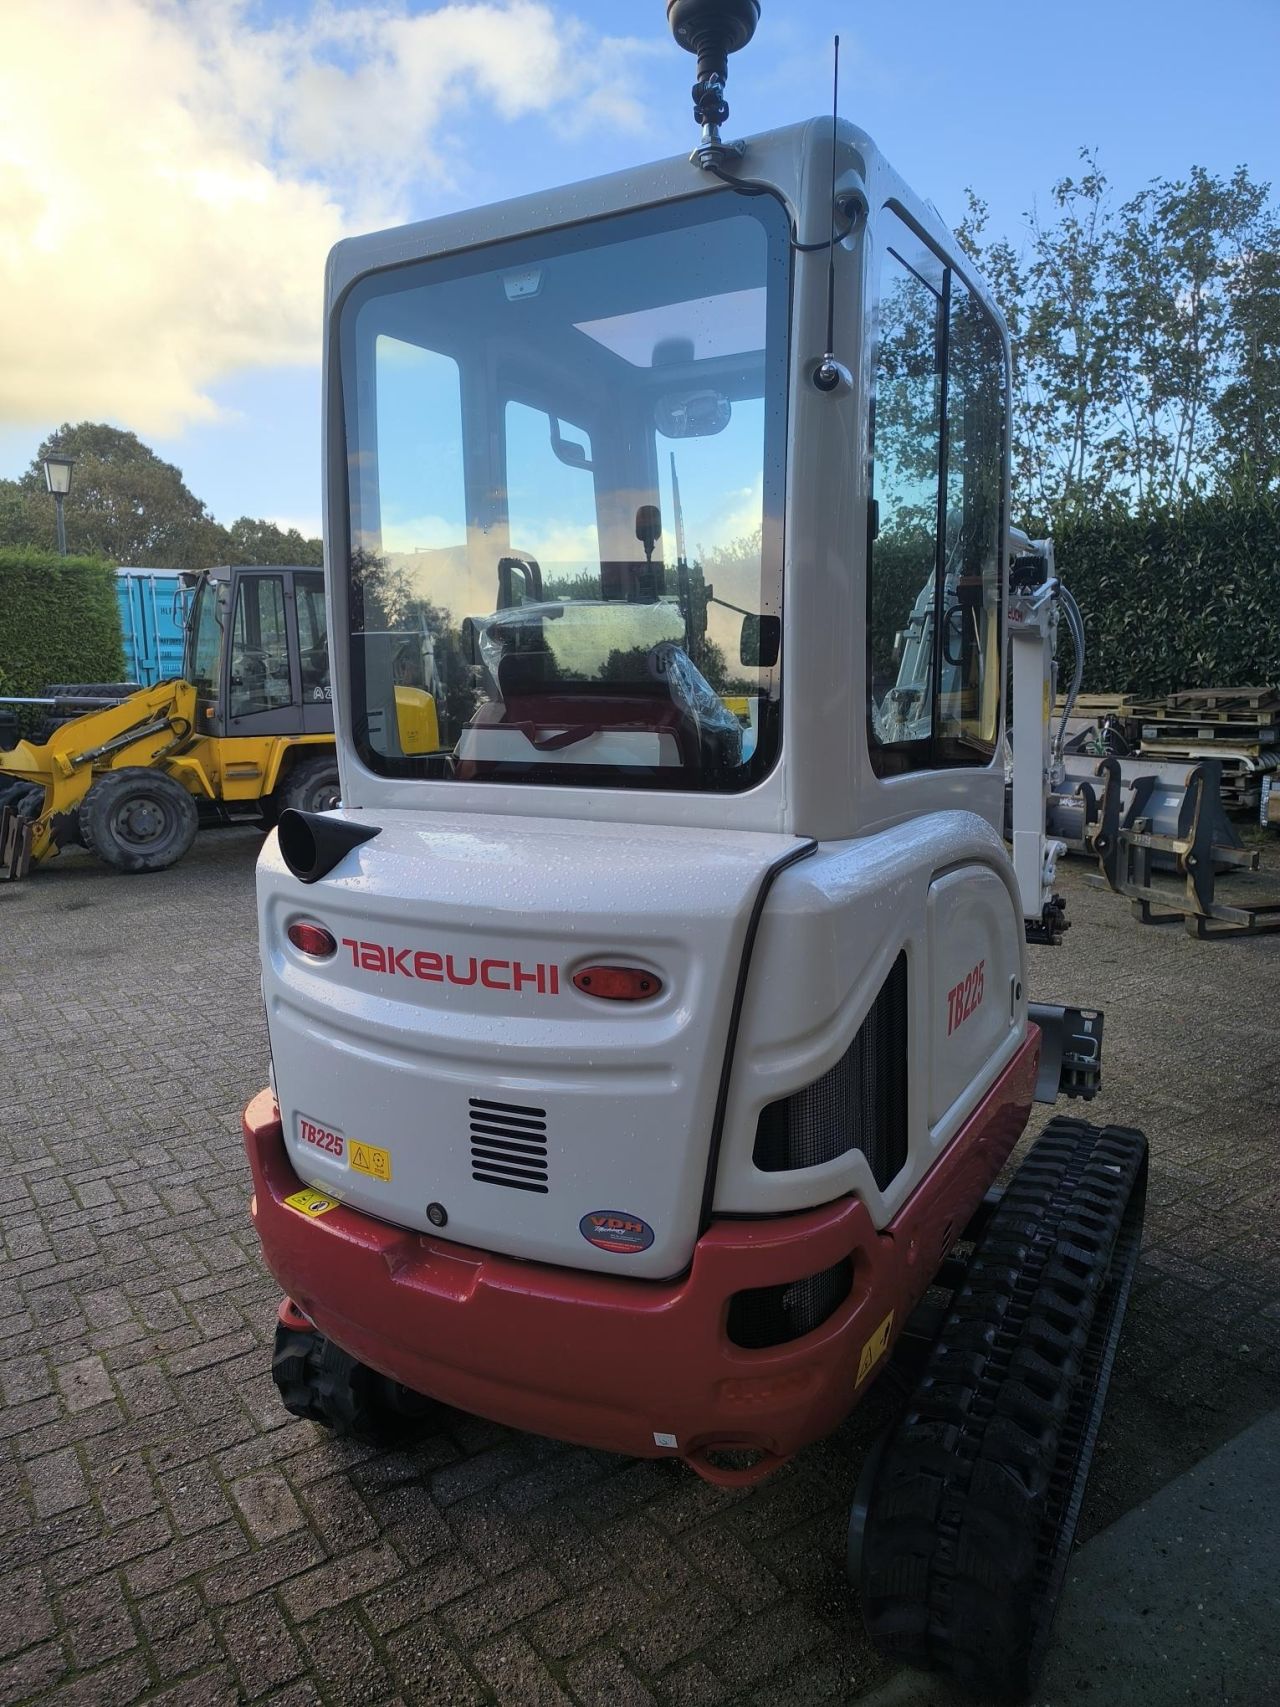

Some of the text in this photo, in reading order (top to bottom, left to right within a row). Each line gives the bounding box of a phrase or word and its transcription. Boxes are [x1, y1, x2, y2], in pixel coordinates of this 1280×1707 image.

[342, 938, 559, 995] TAKEUCHI
[947, 959, 985, 1037] TB225
[300, 1119, 344, 1157] TB225
[590, 1215, 644, 1233] VDH
